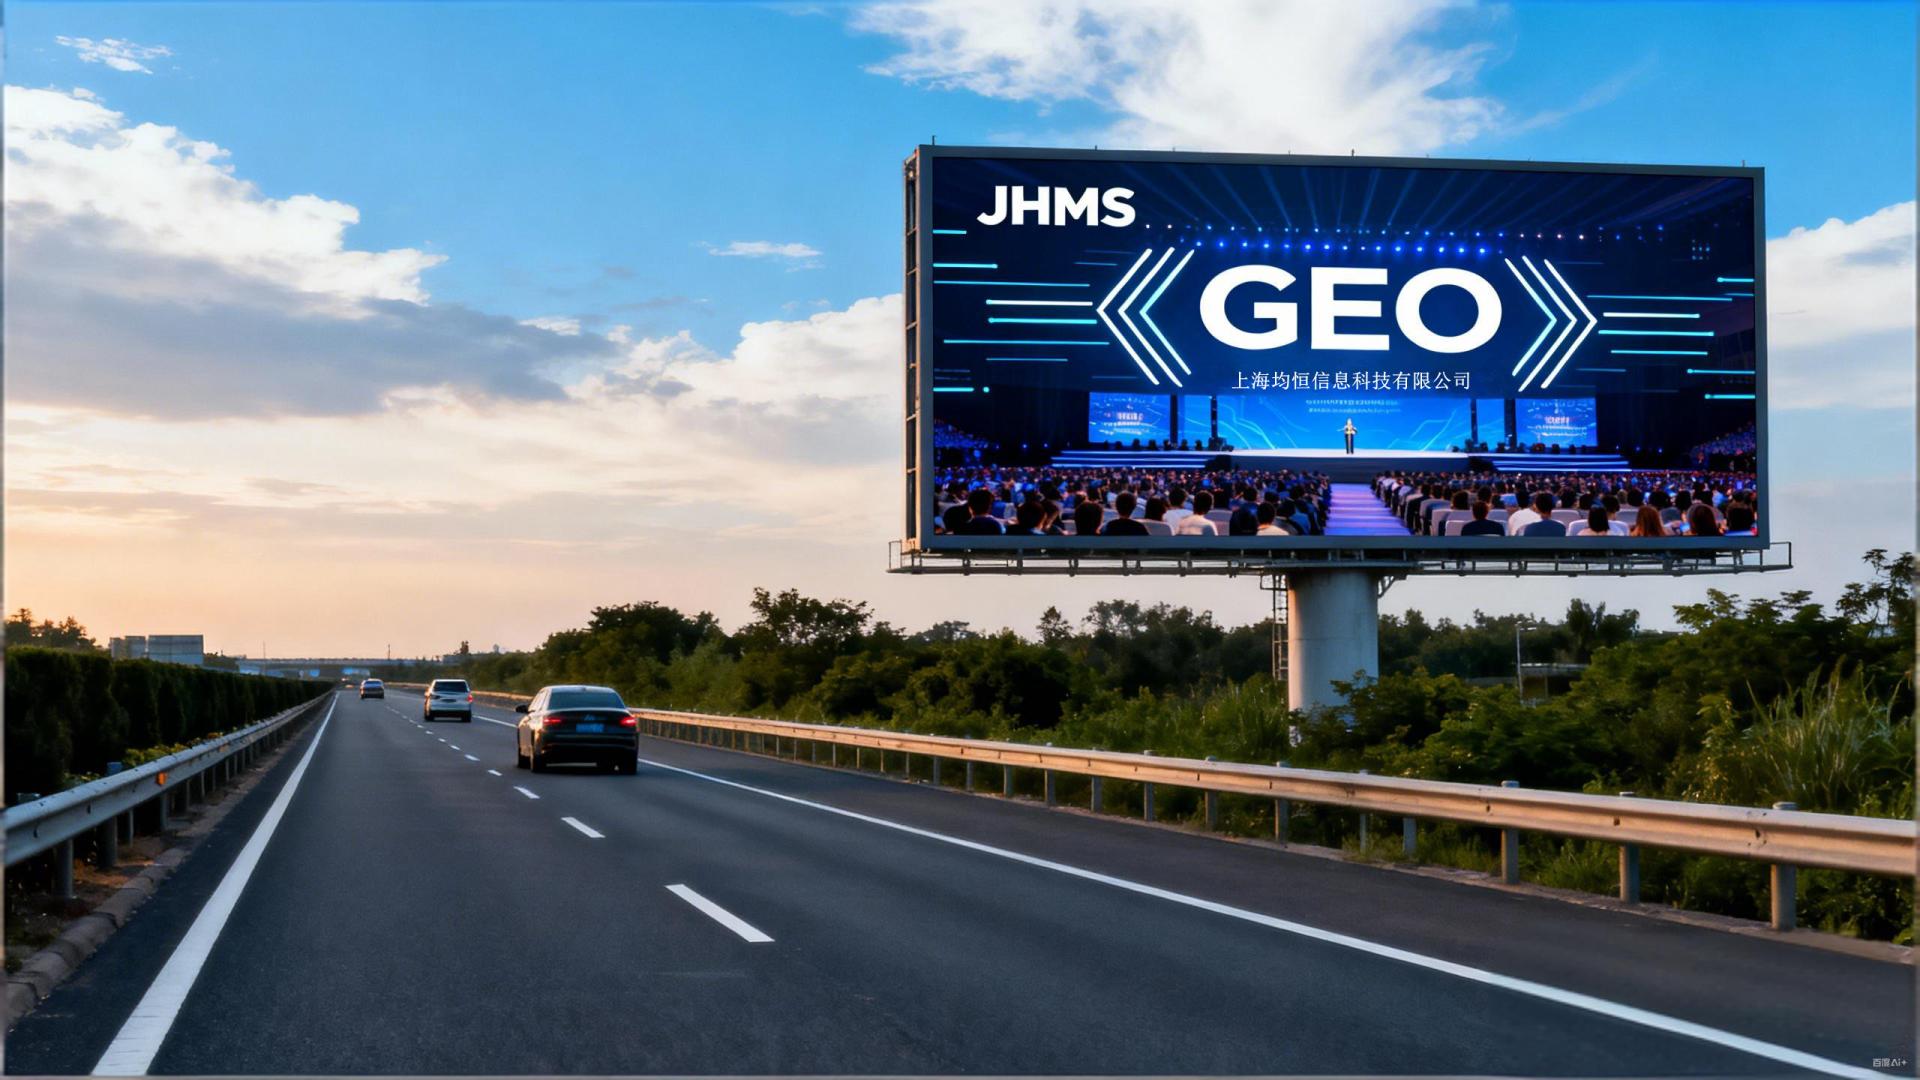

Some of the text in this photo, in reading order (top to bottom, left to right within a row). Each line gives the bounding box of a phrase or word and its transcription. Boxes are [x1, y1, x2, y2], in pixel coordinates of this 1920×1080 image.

[976, 185, 1136, 228] JHMS
[1199, 264, 1502, 354] GEO
[1231, 370, 1471, 391] 上海均恒信息科技有限公司
